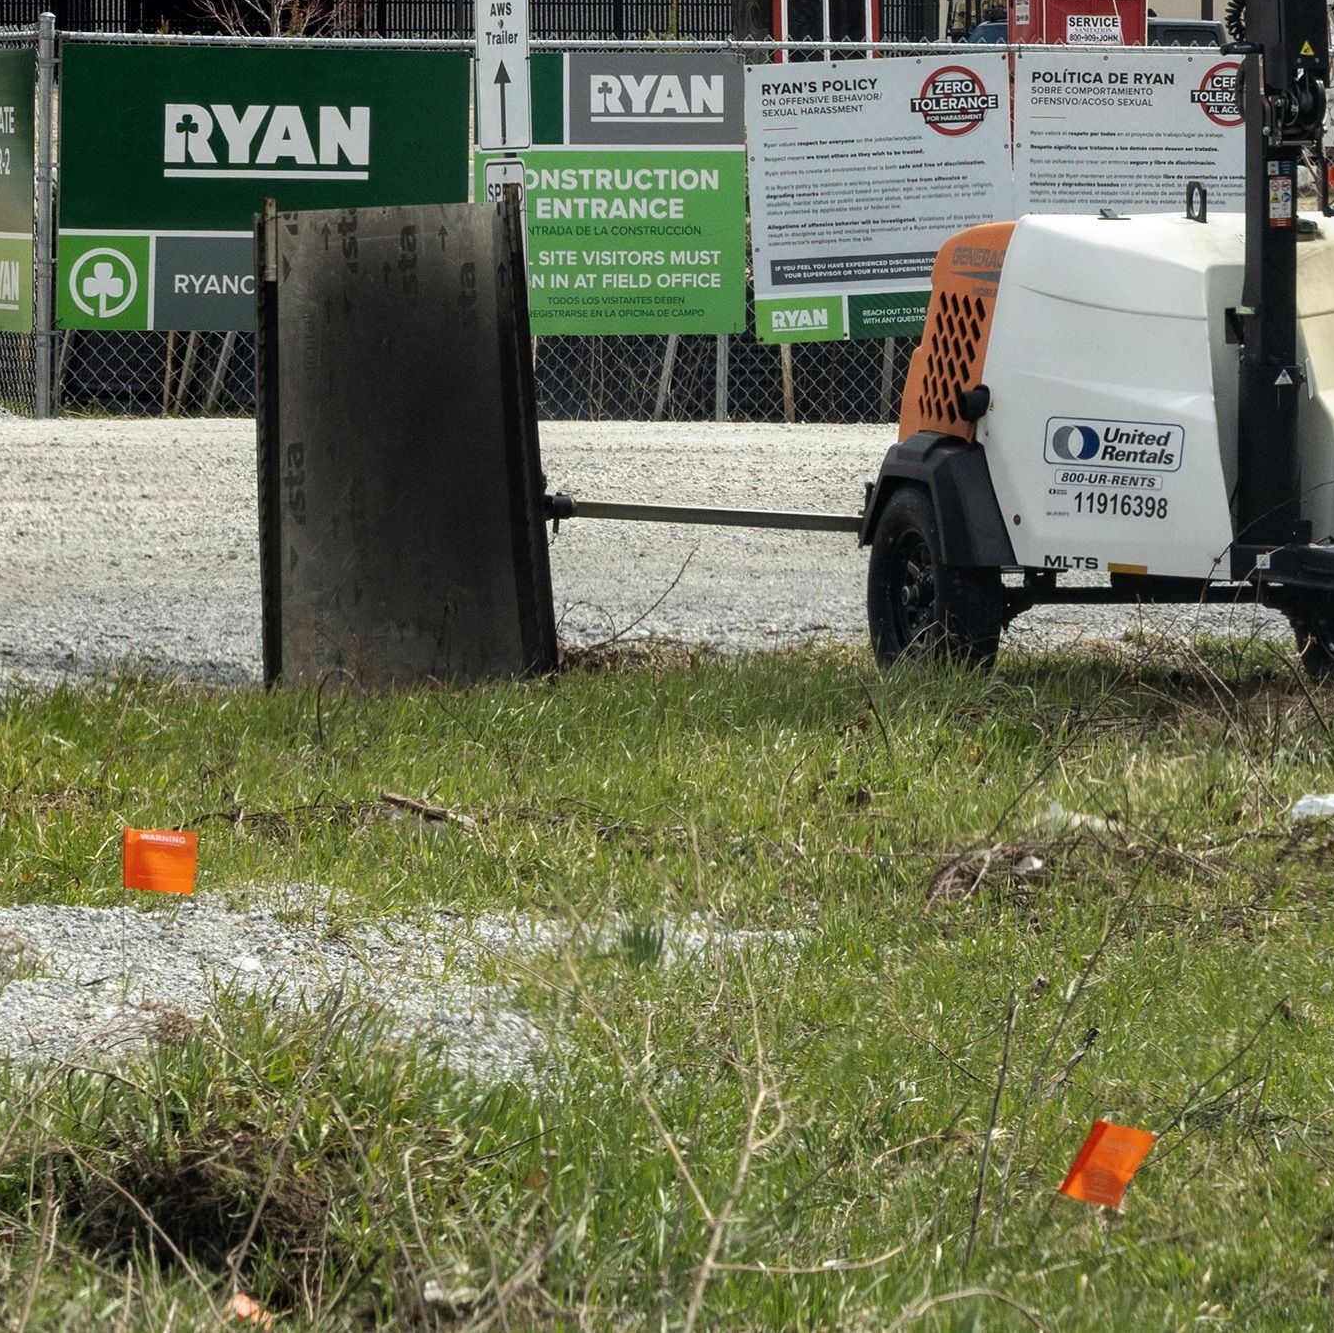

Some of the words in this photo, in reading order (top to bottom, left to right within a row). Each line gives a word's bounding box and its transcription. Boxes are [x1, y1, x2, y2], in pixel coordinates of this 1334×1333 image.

[490, 2, 512, 17] AWS
[1068, 17, 1119, 27] SERVICE
[485, 31, 518, 46] Trailer
[1031, 69, 1103, 84] POLÍTICA
[1108, 73, 1128, 84] DE
[1133, 73, 1175, 85] RYAN
[1213, 77, 1237, 88] CER
[822, 78, 878, 92] POLICY
[934, 81, 972, 94] ZERO
[1031, 86, 1062, 94] SOBRE
[1065, 87, 1153, 96] COMPORTAMIENTO
[590, 74, 724, 114] RYAN
[762, 98, 775, 107] ON
[778, 95, 830, 106] OFFENSIVE
[832, 92, 882, 103] BEHAVIOR/
[1193, 91, 1236, 102] TOLERA
[913, 96, 996, 111] TOLERANCE
[1031, 97, 1114, 106] OFENSIVO/ACOSO
[1117, 98, 1153, 107] SEXUAL
[762, 107, 798, 117] SEXUAL
[800, 105, 863, 116] HARASSMENT
[941, 113, 982, 121] HARASSMENT
[1209, 106, 1219, 114] AL
[164, 103, 370, 165] RYAN
[525, 169, 719, 190] ONSTRUCTION
[536, 198, 684, 219] ENTRANCE
[528, 226, 573, 236] NTRADA
[576, 226, 591, 236] DE
[594, 226, 608, 236] LA
[611, 223, 702, 236] CONSTRUCCIÓN
[538, 251, 577, 266] SITE
[582, 250, 665, 266] VISITORS
[670, 250, 722, 266] MUST
[846, 260, 888, 268] EXPERIENCED
[889, 258, 935, 266] DISCRIMINATIO
[803, 270, 841, 278] SUPERVISOR
[890, 265, 932, 273] SUPERINTEND
[174, 274, 255, 295] RYANC
[550, 274, 569, 288] IN
[573, 273, 594, 288] AT
[602, 273, 651, 288] FIELD
[656, 273, 721, 288] OFFICE
[548, 296, 579, 305] TODOS
[581, 296, 599, 305] LOS
[602, 296, 653, 305] VISITANTES
[655, 296, 685, 305] DEBEN
[590, 309, 603, 318] EN
[605, 309, 616, 318] LA
[618, 309, 655, 317] OFICINA
[657, 309, 670, 317] DE
[672, 309, 705, 317] CAMPO
[771, 308, 828, 328] RYAN
[897, 314, 927, 323] QUESTIO
[1104, 427, 1171, 446] United
[1101, 445, 1175, 465] Rentals
[1061, 472, 1156, 488] 800-UR-RENTS
[1074, 491, 1168, 519] 11916398
[1044, 555, 1099, 570] MLTS
